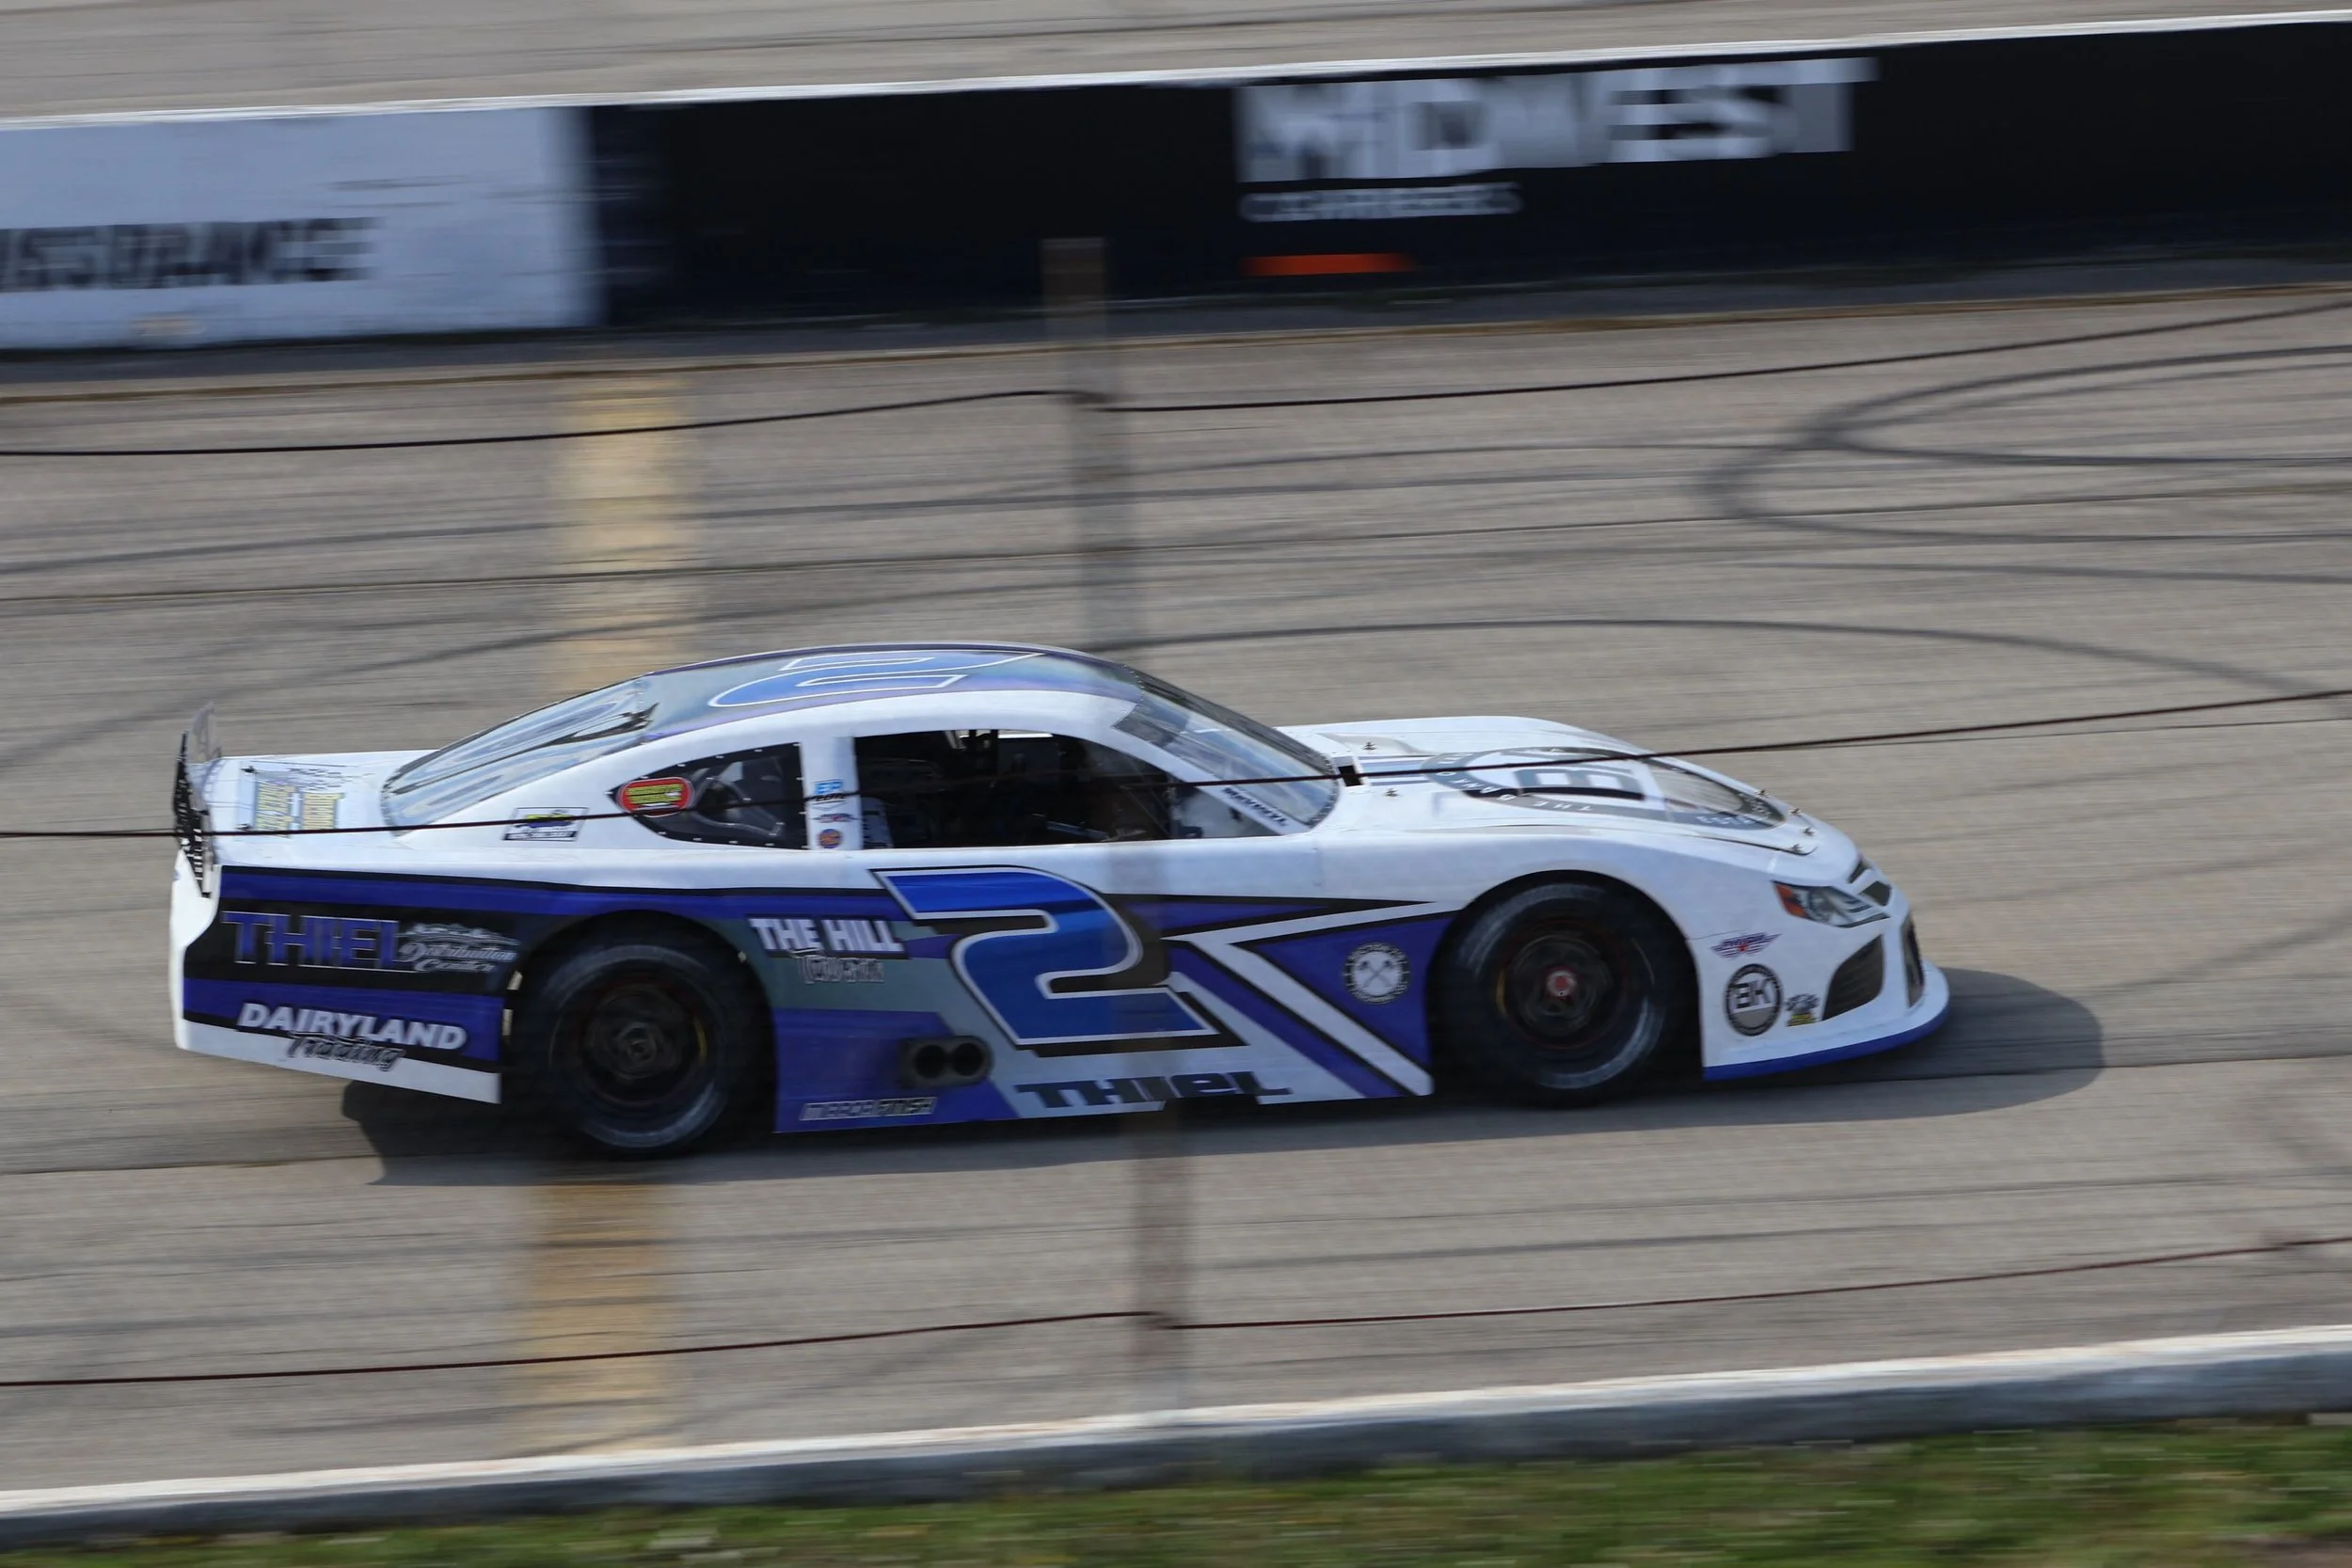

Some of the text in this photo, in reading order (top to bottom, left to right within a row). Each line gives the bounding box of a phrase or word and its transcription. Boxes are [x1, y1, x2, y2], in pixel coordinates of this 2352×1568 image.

[221, 911, 412, 973] THIEL
[748, 917, 905, 952] THE HILL
[870, 864, 1223, 1048] 2
[237, 1003, 469, 1050] DAIRYLAND
